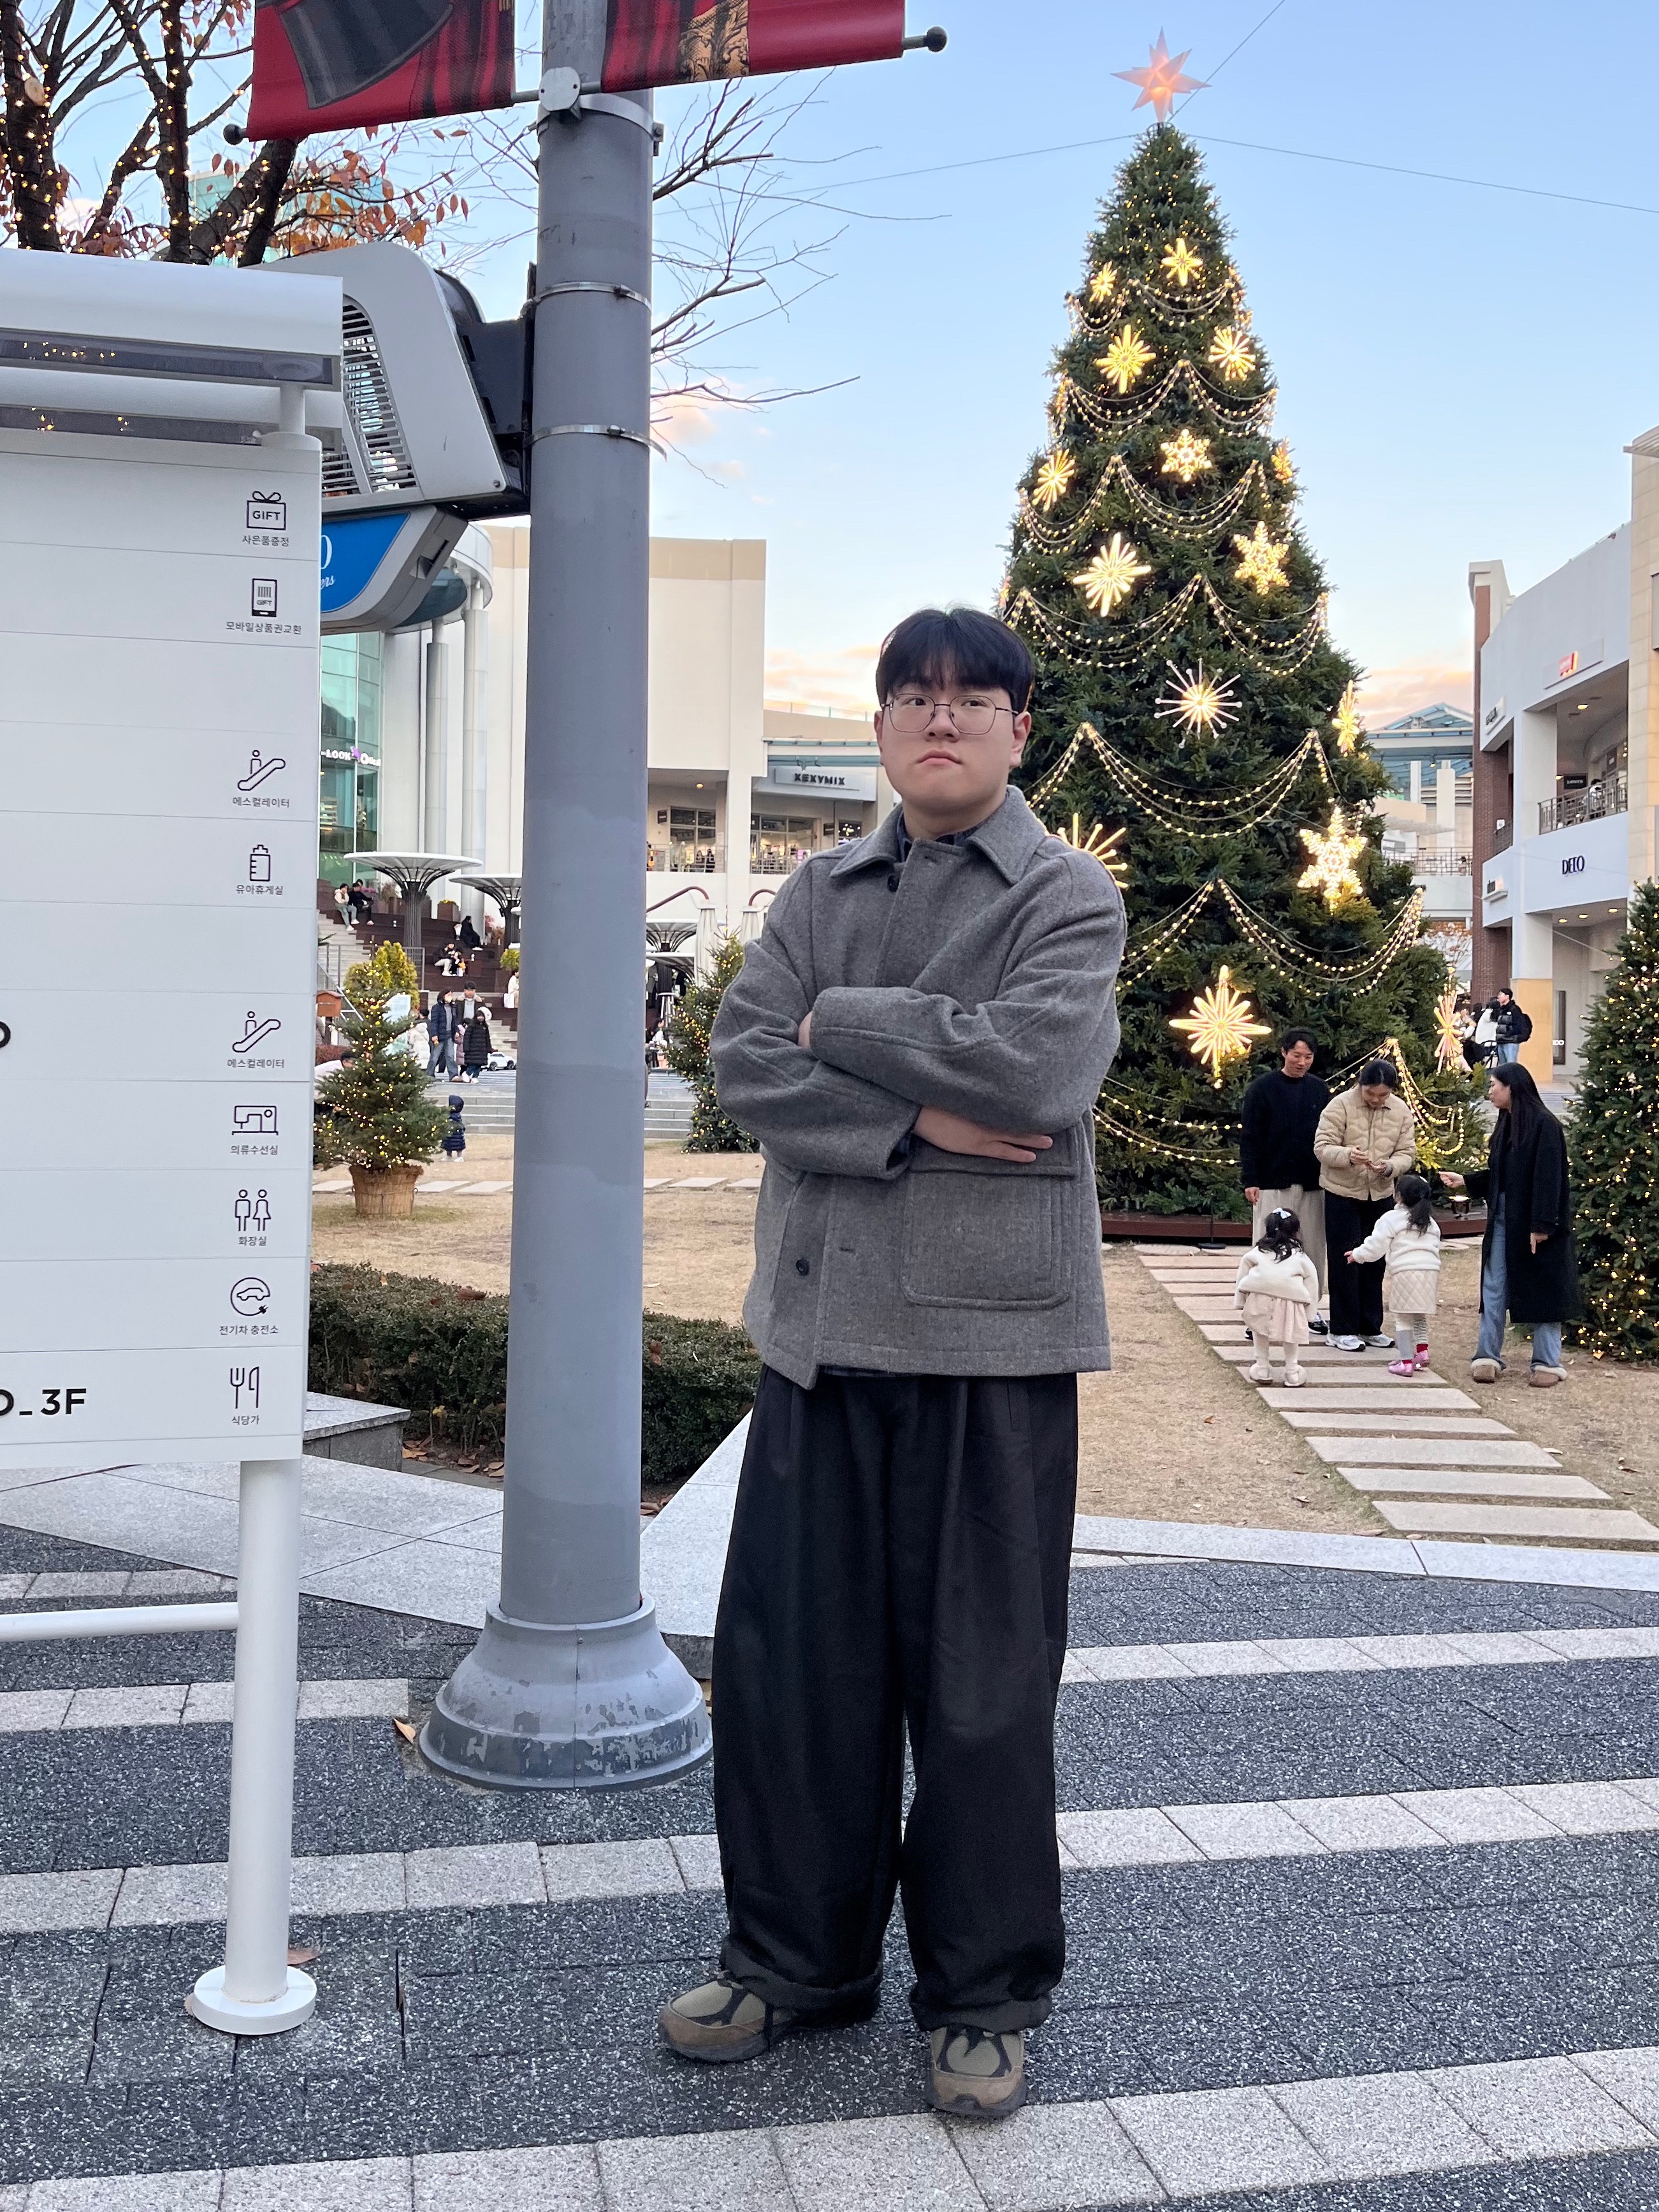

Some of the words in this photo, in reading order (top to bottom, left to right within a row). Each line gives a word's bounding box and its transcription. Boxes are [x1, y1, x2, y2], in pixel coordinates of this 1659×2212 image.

[252, 511, 280, 520] GIFT
[242, 535, 289, 547] 사은품증정
[226, 622, 301, 635] 모바일상품권교환
[794, 773, 845, 785] XEXYMIX
[232, 797, 290, 808] 에스컬레이터
[236, 884, 284, 895] 유아휴게실
[227, 1058, 285, 1068] 에스컬레이터
[230, 1145, 279, 1155] 의류수선실
[238, 1236, 267, 1246] 화장실
[219, 1325, 248, 1335] 전기차
[250, 1325, 279, 1335] 충전소
[231, 1415, 259, 1425] 식당가
